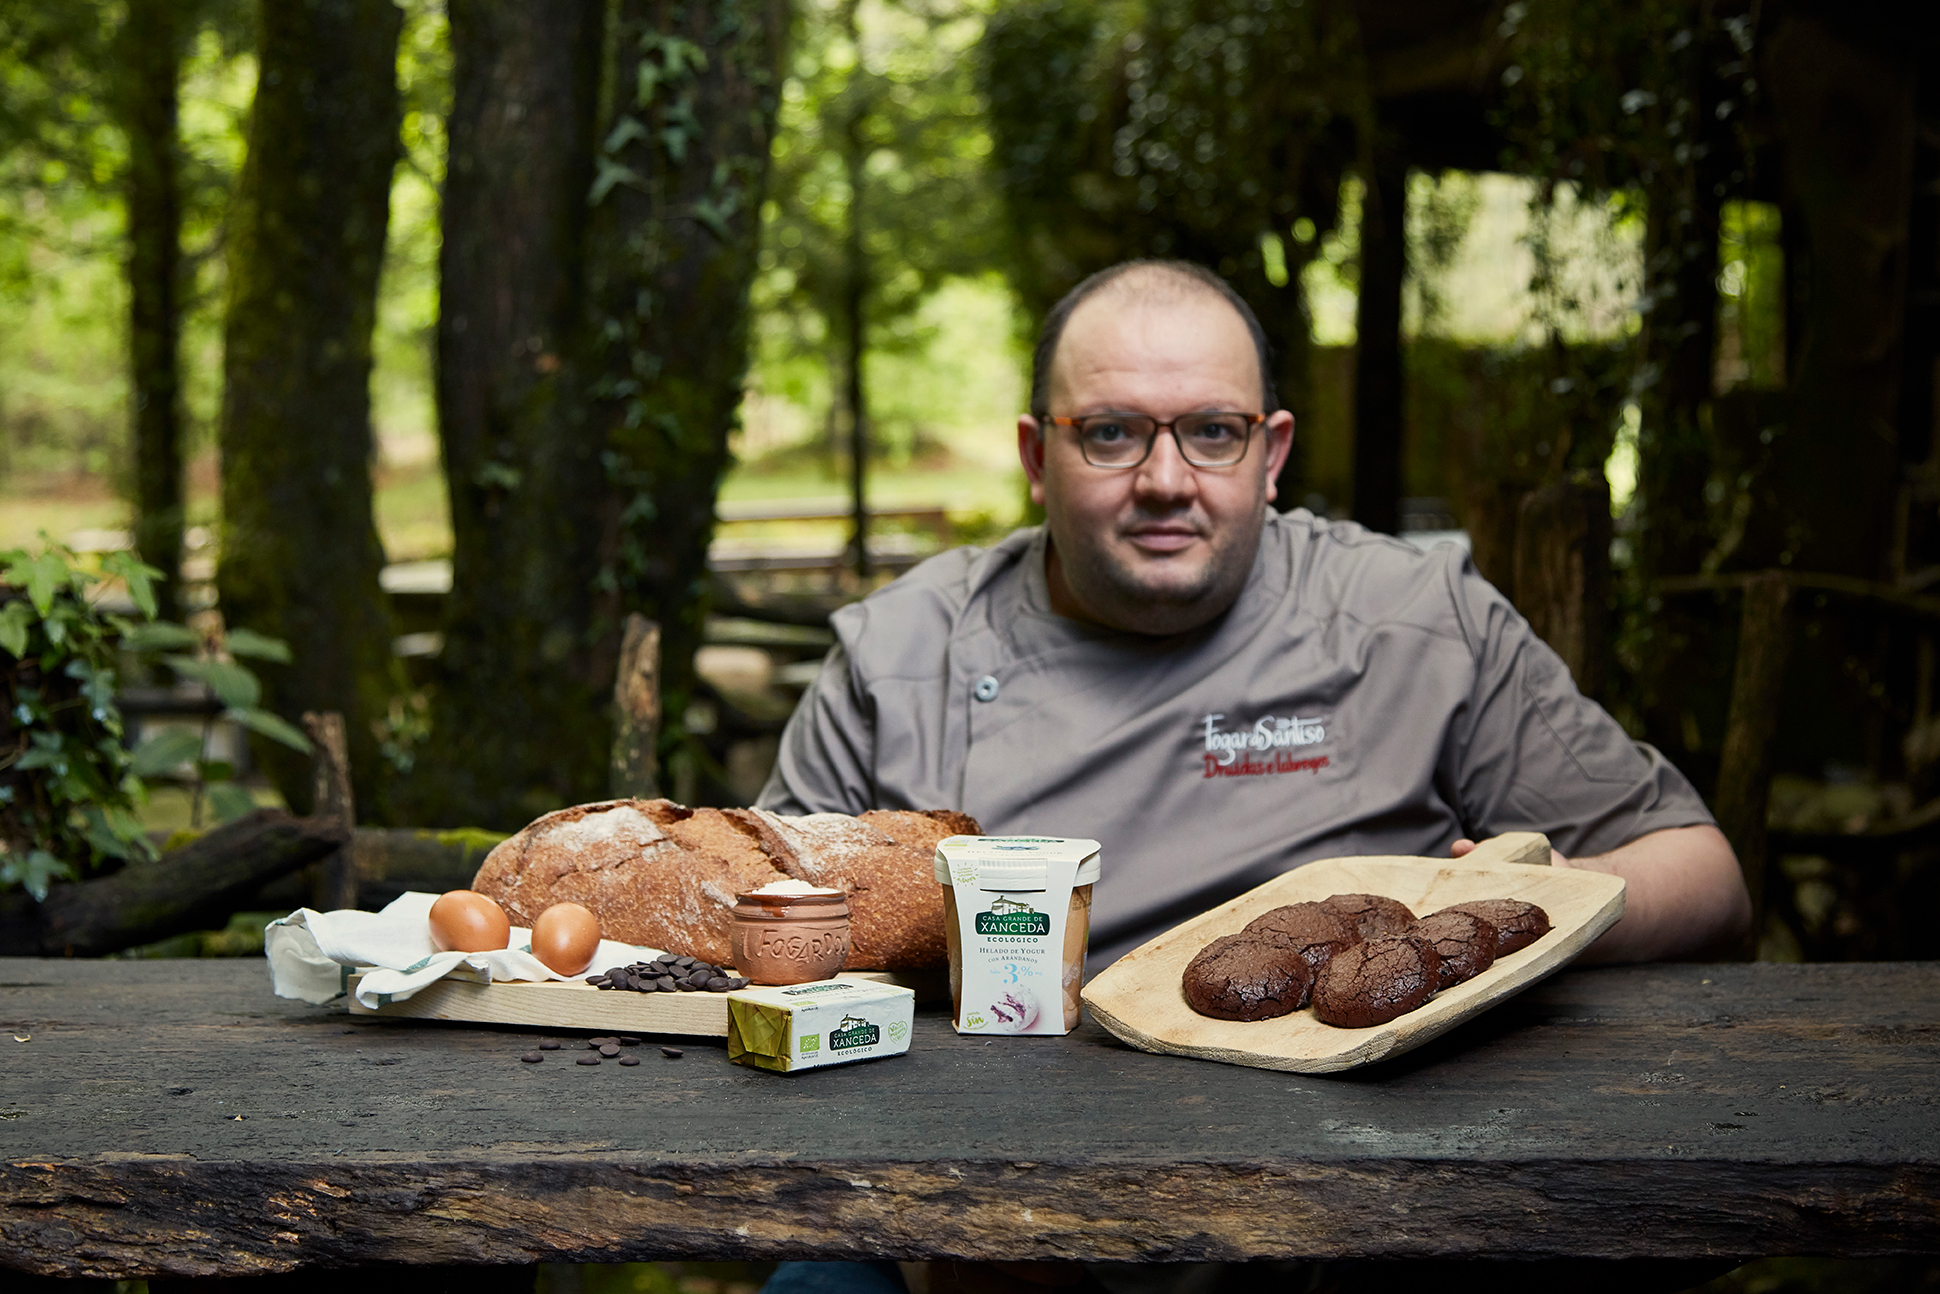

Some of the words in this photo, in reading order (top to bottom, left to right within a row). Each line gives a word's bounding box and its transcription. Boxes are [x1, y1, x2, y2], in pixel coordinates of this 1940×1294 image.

[1255, 714, 1325, 751] Santiso
[980, 921, 1046, 933] XANCEDA
[833, 1034, 877, 1048] XANCEDA
